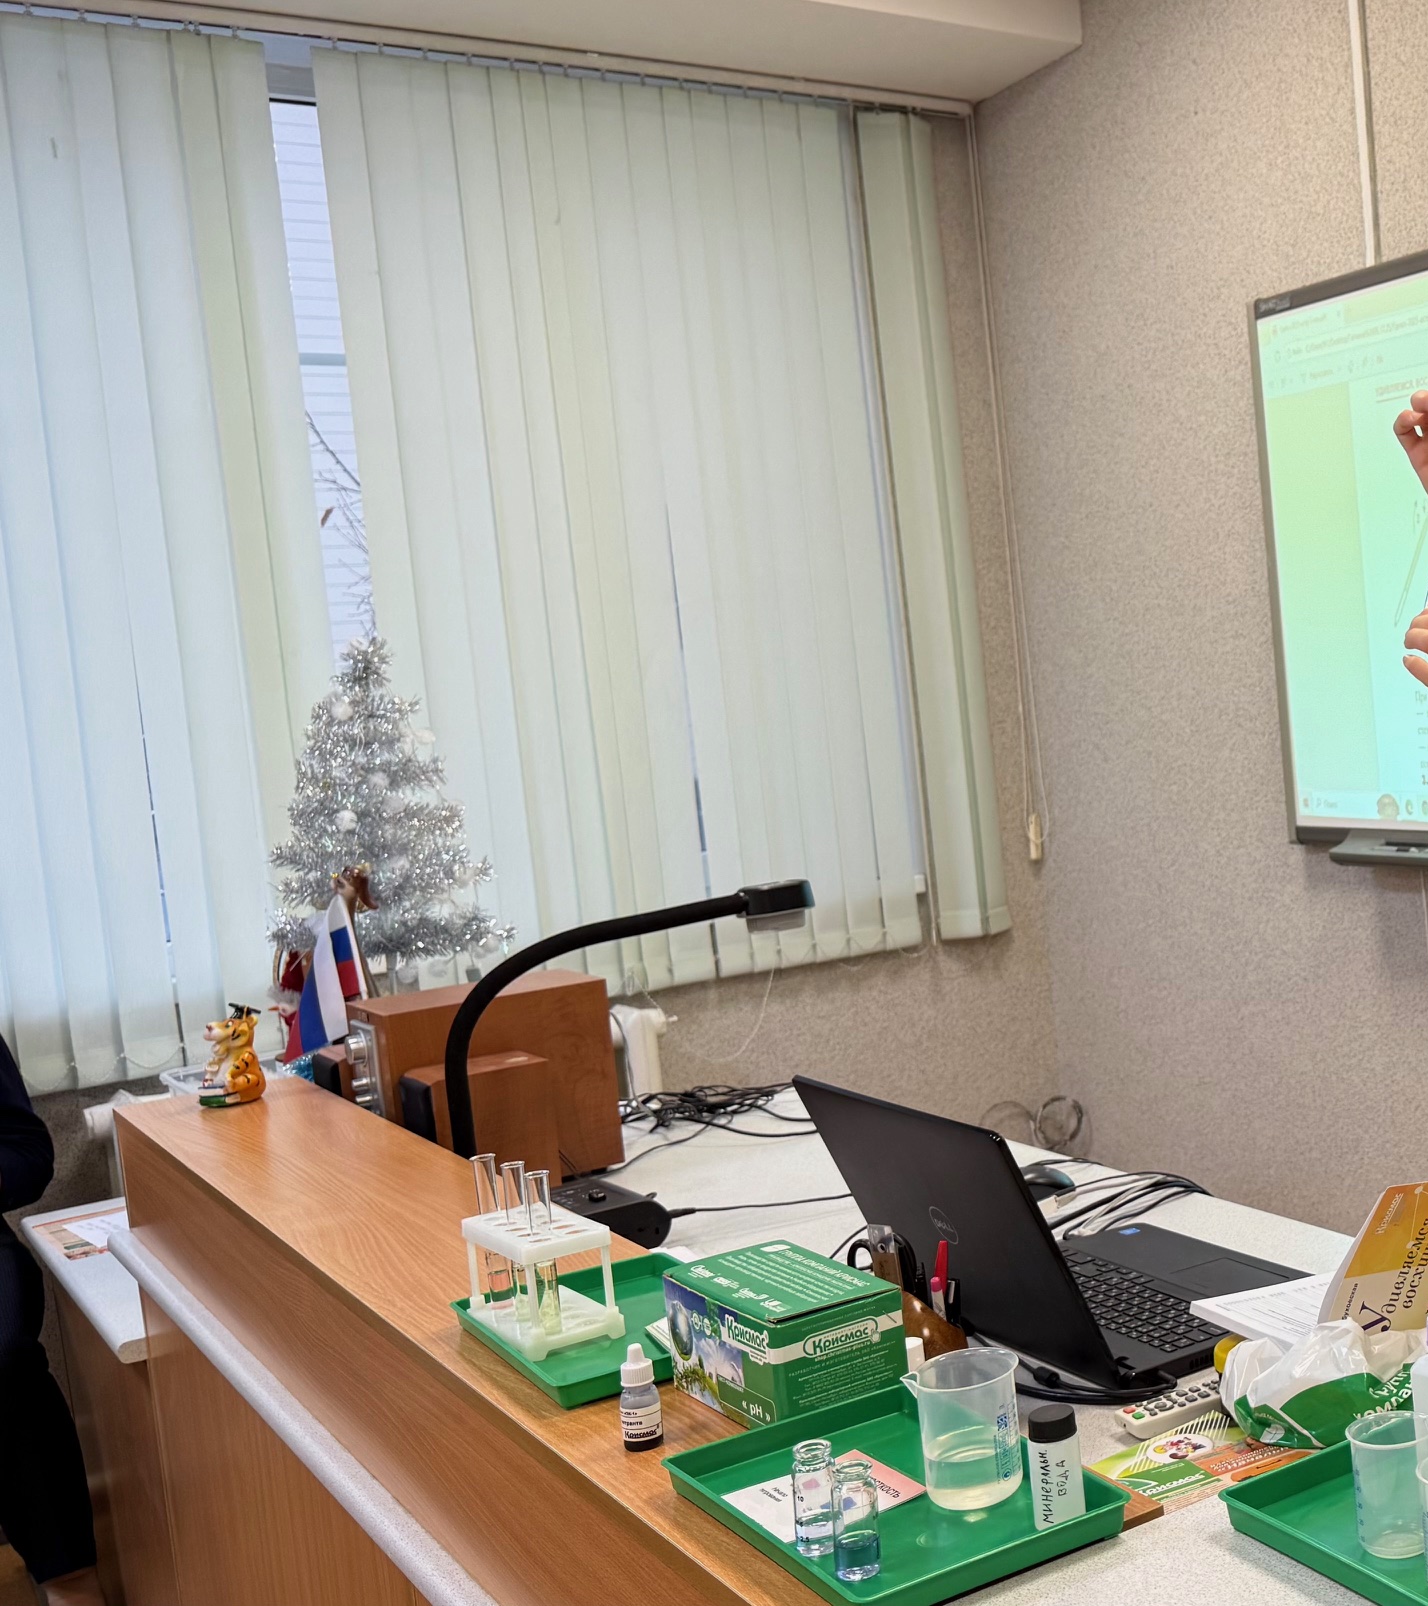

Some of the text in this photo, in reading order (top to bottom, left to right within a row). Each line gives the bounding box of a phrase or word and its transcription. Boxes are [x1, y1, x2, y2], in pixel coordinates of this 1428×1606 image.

[725, 1315, 766, 1350] Крисмас
[812, 1327, 869, 1355] Крисмас
[750, 1403, 763, 1419] pH
[797, 1495, 805, 1503] 10
